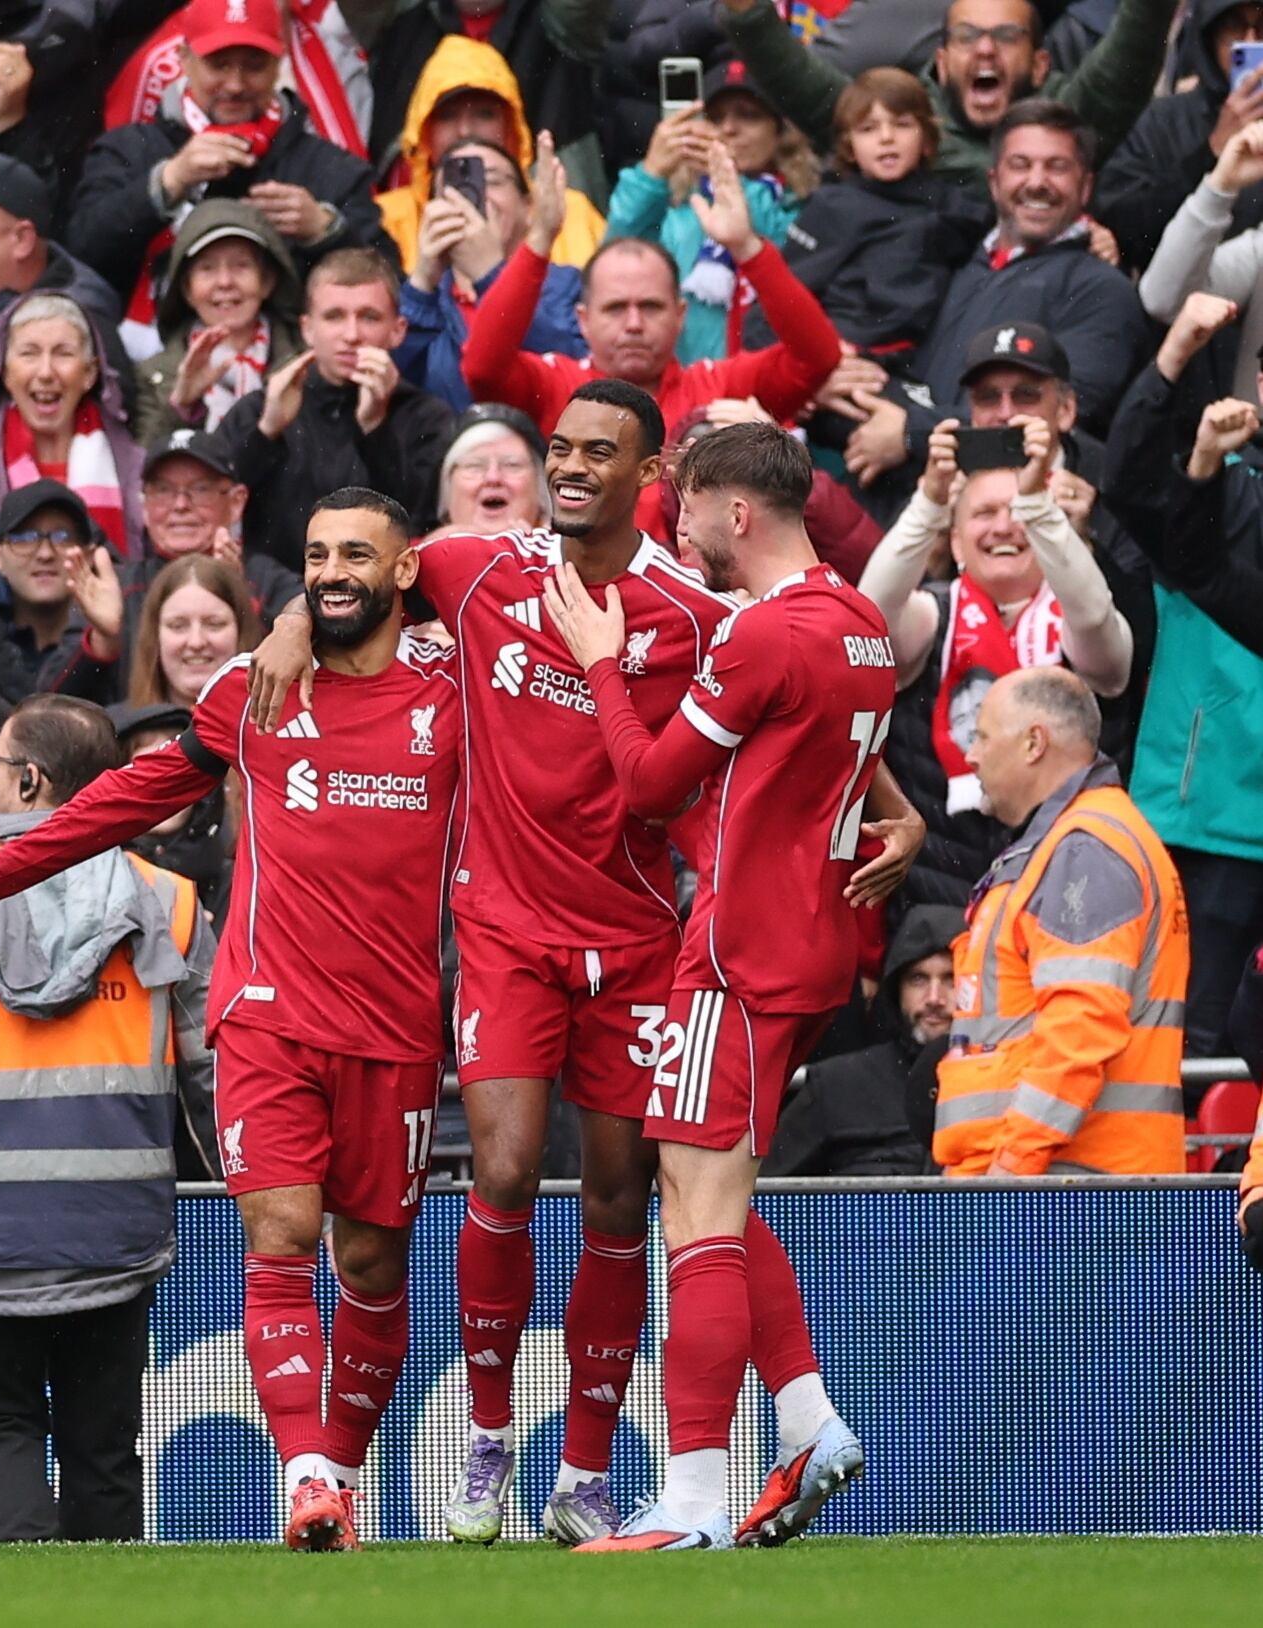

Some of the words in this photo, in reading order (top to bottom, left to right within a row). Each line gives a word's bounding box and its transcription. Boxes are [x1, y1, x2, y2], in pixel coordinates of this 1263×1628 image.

[327, 769, 426, 793] standard
[327, 788, 428, 811] chartered
[404, 1108, 433, 1174] 11
[262, 1323, 310, 1341] LFC
[464, 1311, 507, 1330] LFC
[585, 1344, 633, 1361] LFC
[342, 1354, 392, 1379] LFC
